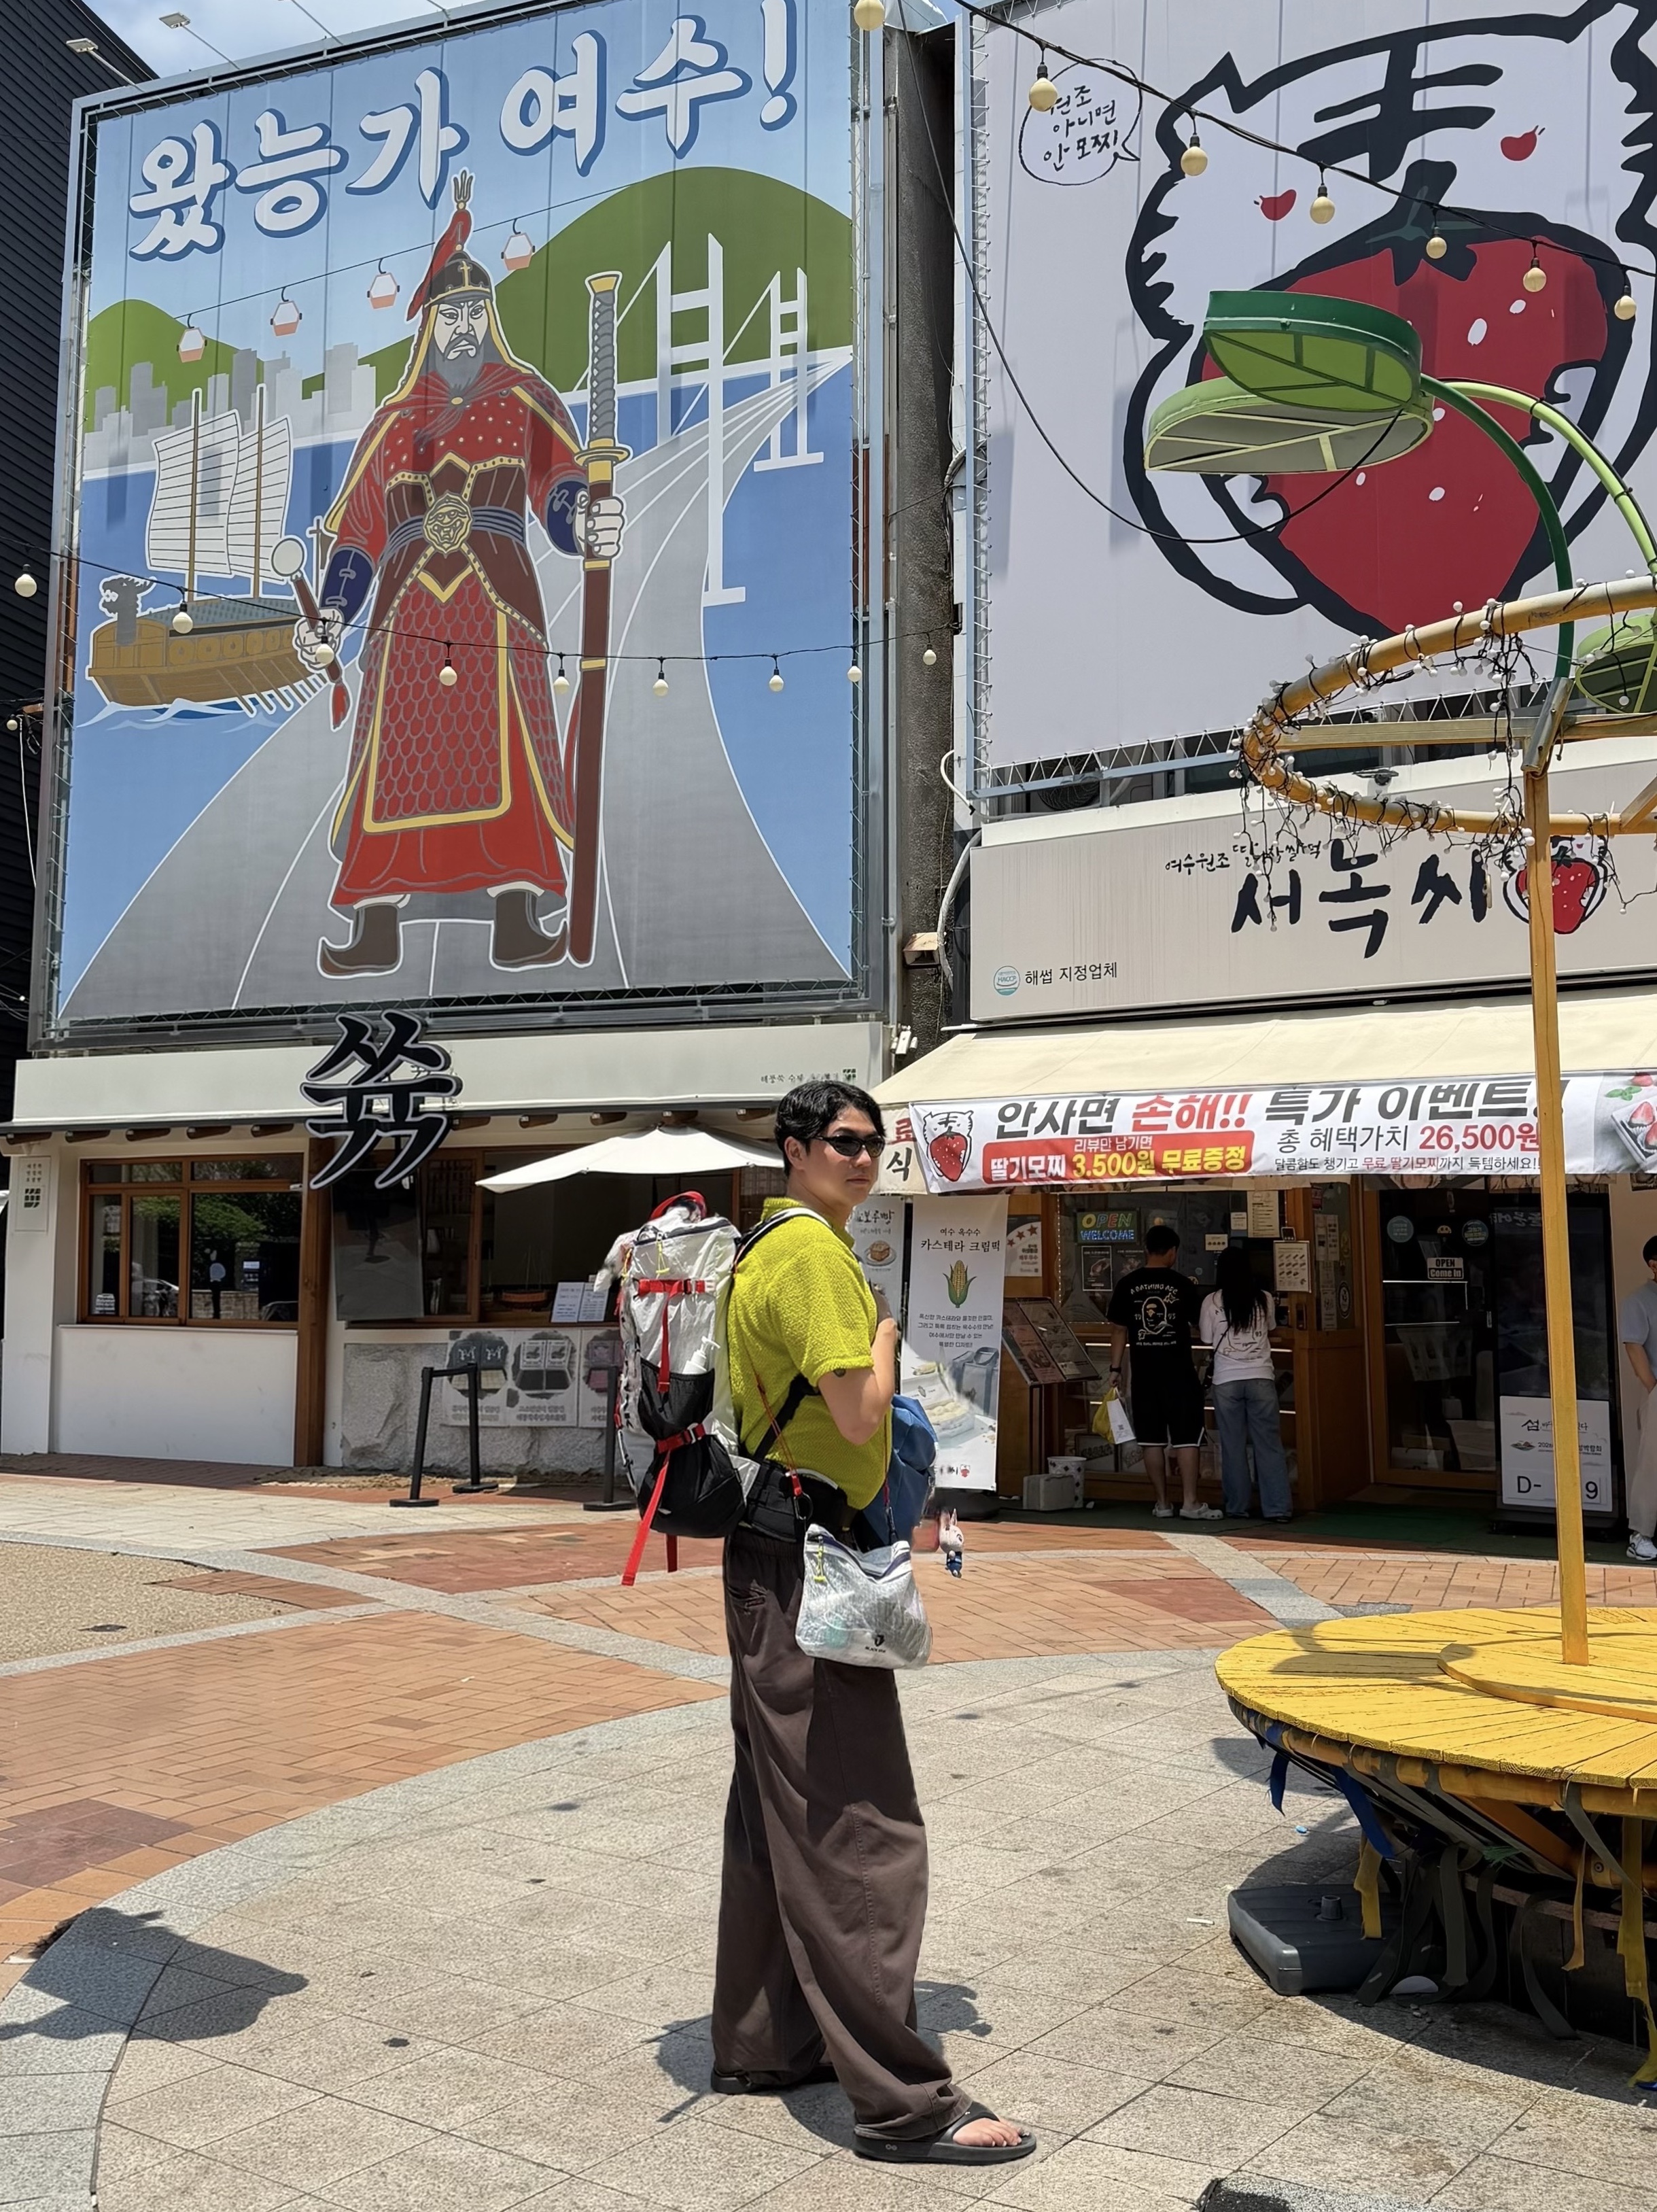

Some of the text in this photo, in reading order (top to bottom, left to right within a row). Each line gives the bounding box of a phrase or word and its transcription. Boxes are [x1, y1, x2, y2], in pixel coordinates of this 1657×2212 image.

[1053, 100, 1116, 137] 아니면
[128, 0, 807, 261] 왔능가 여수!
[1043, 130, 1118, 172] 안 모찌
[1165, 852, 1230, 876] 여수원조
[1025, 962, 1117, 986] 해썹 지정업체
[996, 1096, 1120, 1139] 안사면
[1132, 1094, 1253, 1131] 손해!!
[1265, 1088, 1361, 1125] 특가
[1074, 1135, 1153, 1154] 리뷰만 남기면
[1277, 1122, 1539, 1154] 총 혜택가치 26,500원
[990, 1155, 1066, 1179] 딸기모찌
[1162, 1145, 1246, 1175] 무료증정
[1275, 1157, 1321, 1171] 달콤함도
[1323, 1157, 1358, 1170] 챙기고
[1362, 1157, 1386, 1169] 무료
[1391, 1156, 1464, 1170] 딸기모찌까지
[1082, 1213, 1132, 1228] OPEN
[940, 1228, 955, 1236] 여수
[1080, 1230, 1134, 1241] WELCOME
[921, 1239, 965, 1253] 카스테라
[1430, 1268, 1452, 1277] Come
[1435, 1259, 1455, 1268] OPEN
